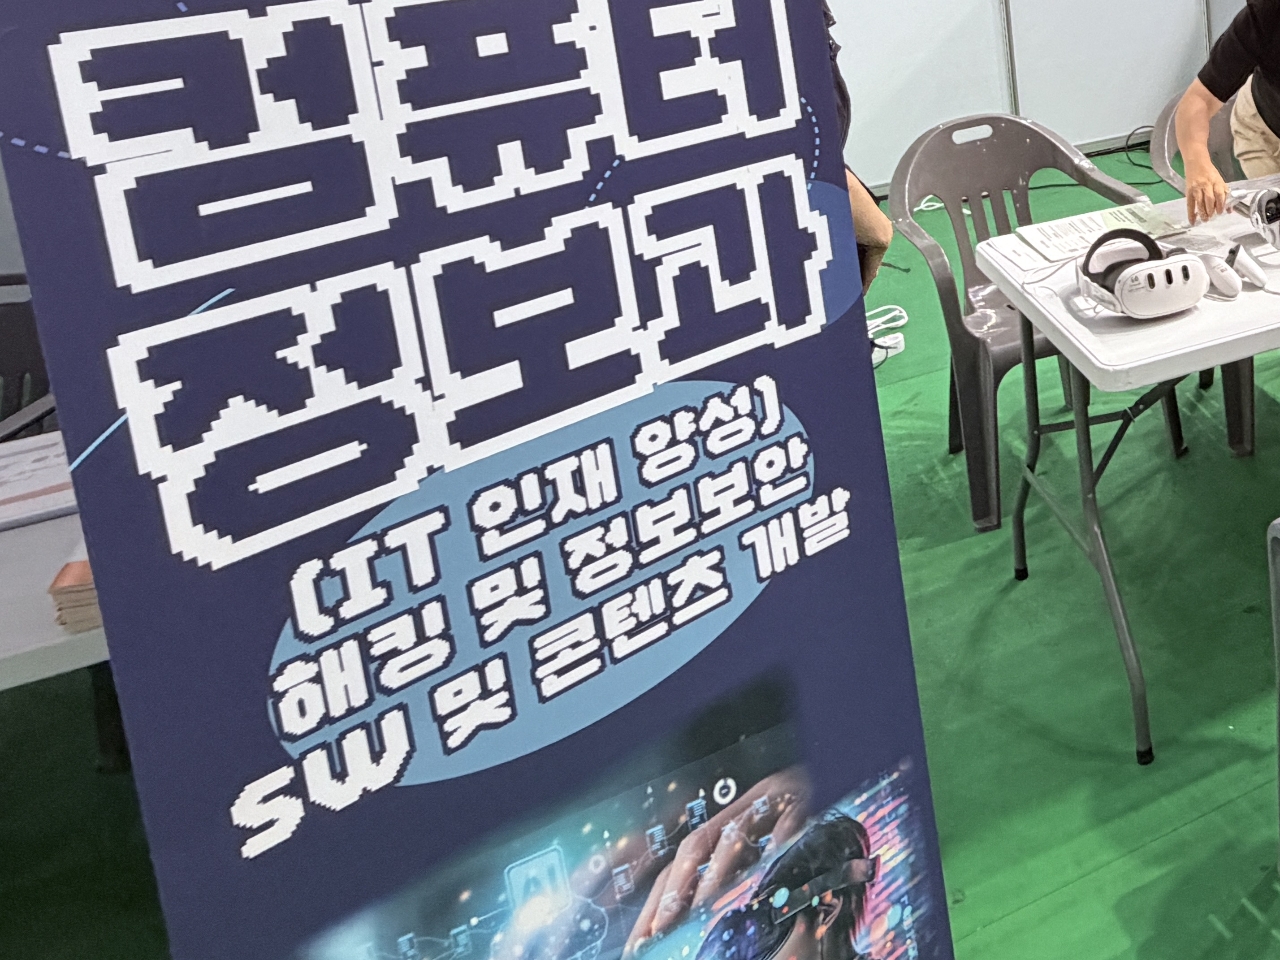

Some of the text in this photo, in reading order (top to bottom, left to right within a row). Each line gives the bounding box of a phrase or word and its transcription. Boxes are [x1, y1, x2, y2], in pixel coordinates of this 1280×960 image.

[107, 154, 833, 571] 정보과
[290, 375, 784, 638] (IT 인재 양성)
[230, 487, 851, 859] SW 및 콘텐츠 개발
[273, 437, 810, 742] 해킹 및 정보보안
